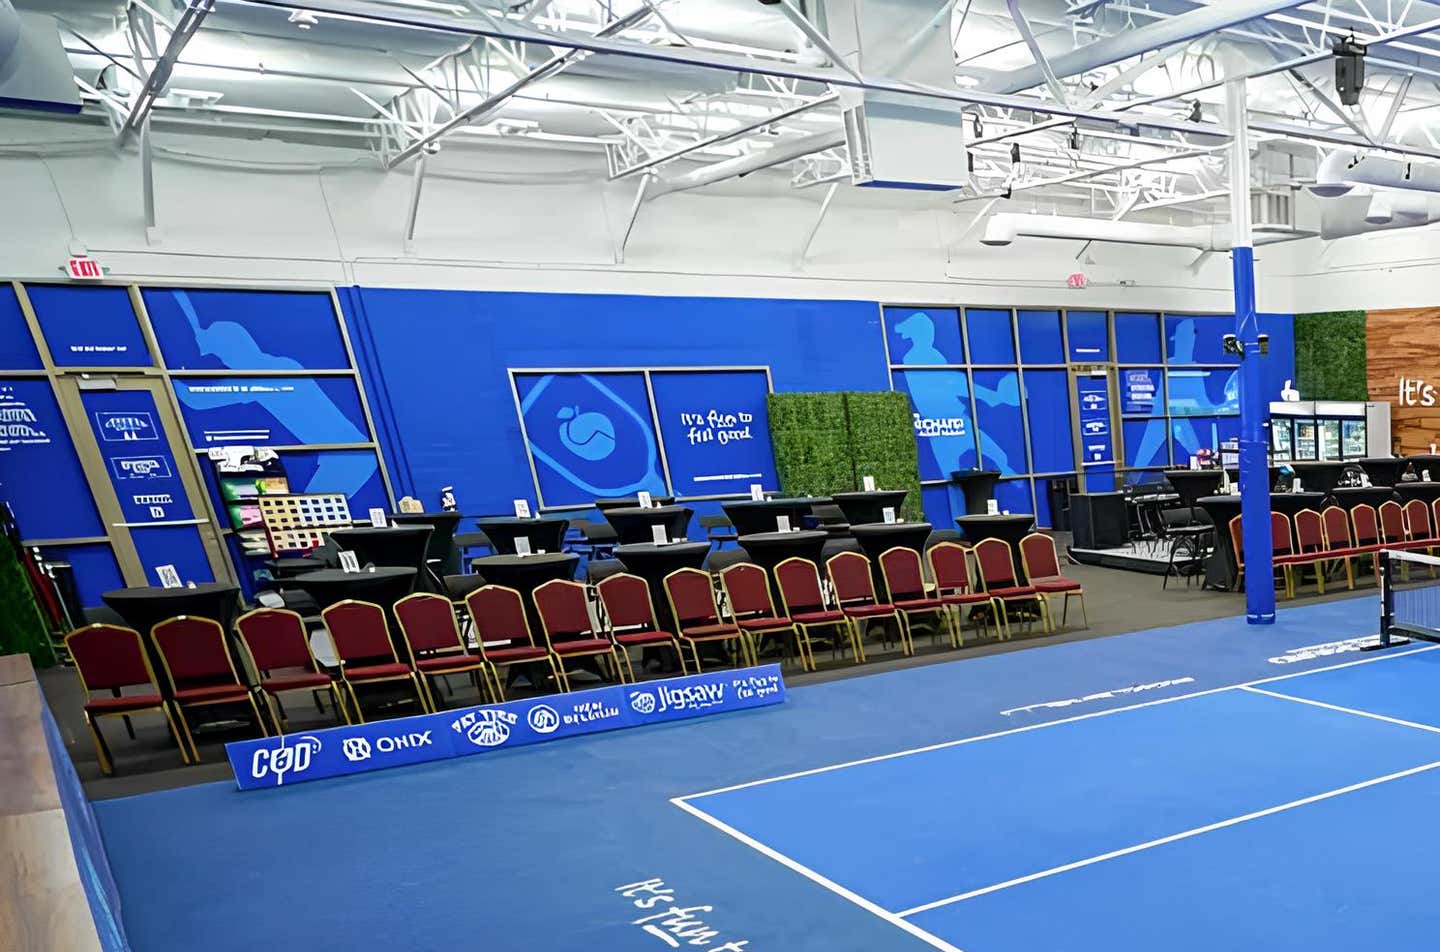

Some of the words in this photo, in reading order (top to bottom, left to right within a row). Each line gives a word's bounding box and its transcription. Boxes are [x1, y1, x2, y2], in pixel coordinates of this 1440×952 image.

[1399, 376, 1436, 406] It's
[376, 731, 432, 752] ONIX
[614, 877, 675, 909] It's
[632, 904, 719, 947] fun
